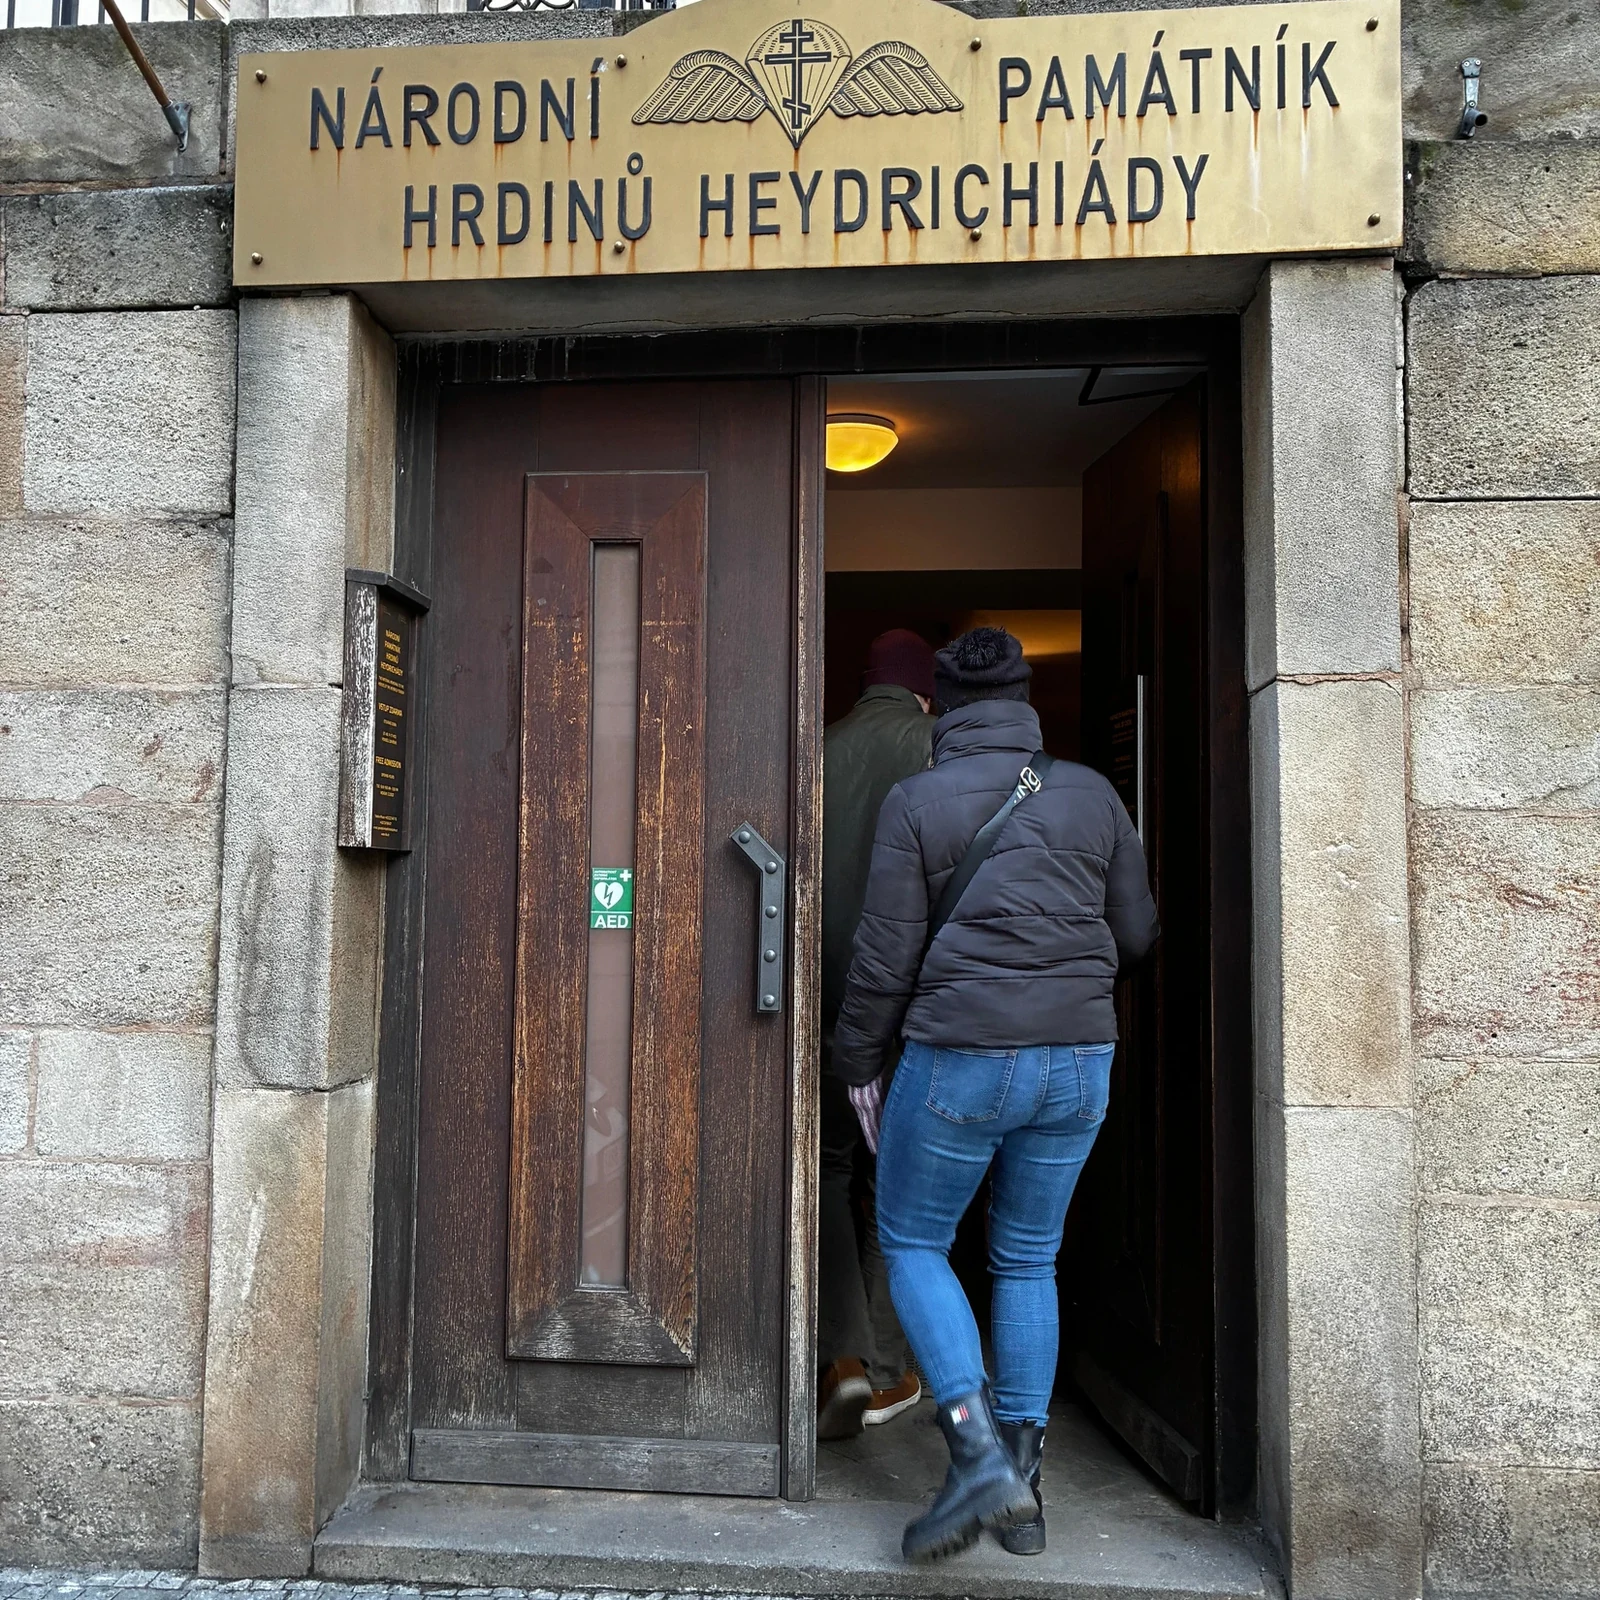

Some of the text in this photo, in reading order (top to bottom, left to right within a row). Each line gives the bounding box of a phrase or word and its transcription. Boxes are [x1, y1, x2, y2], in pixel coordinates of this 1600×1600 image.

[310, 24, 1340, 150] NÁRODNÍ PAMÁTNÍK
[404, 138, 1210, 248] HRDINŮ HEYDRICHIÁDY
[594, 914, 629, 929] AED
